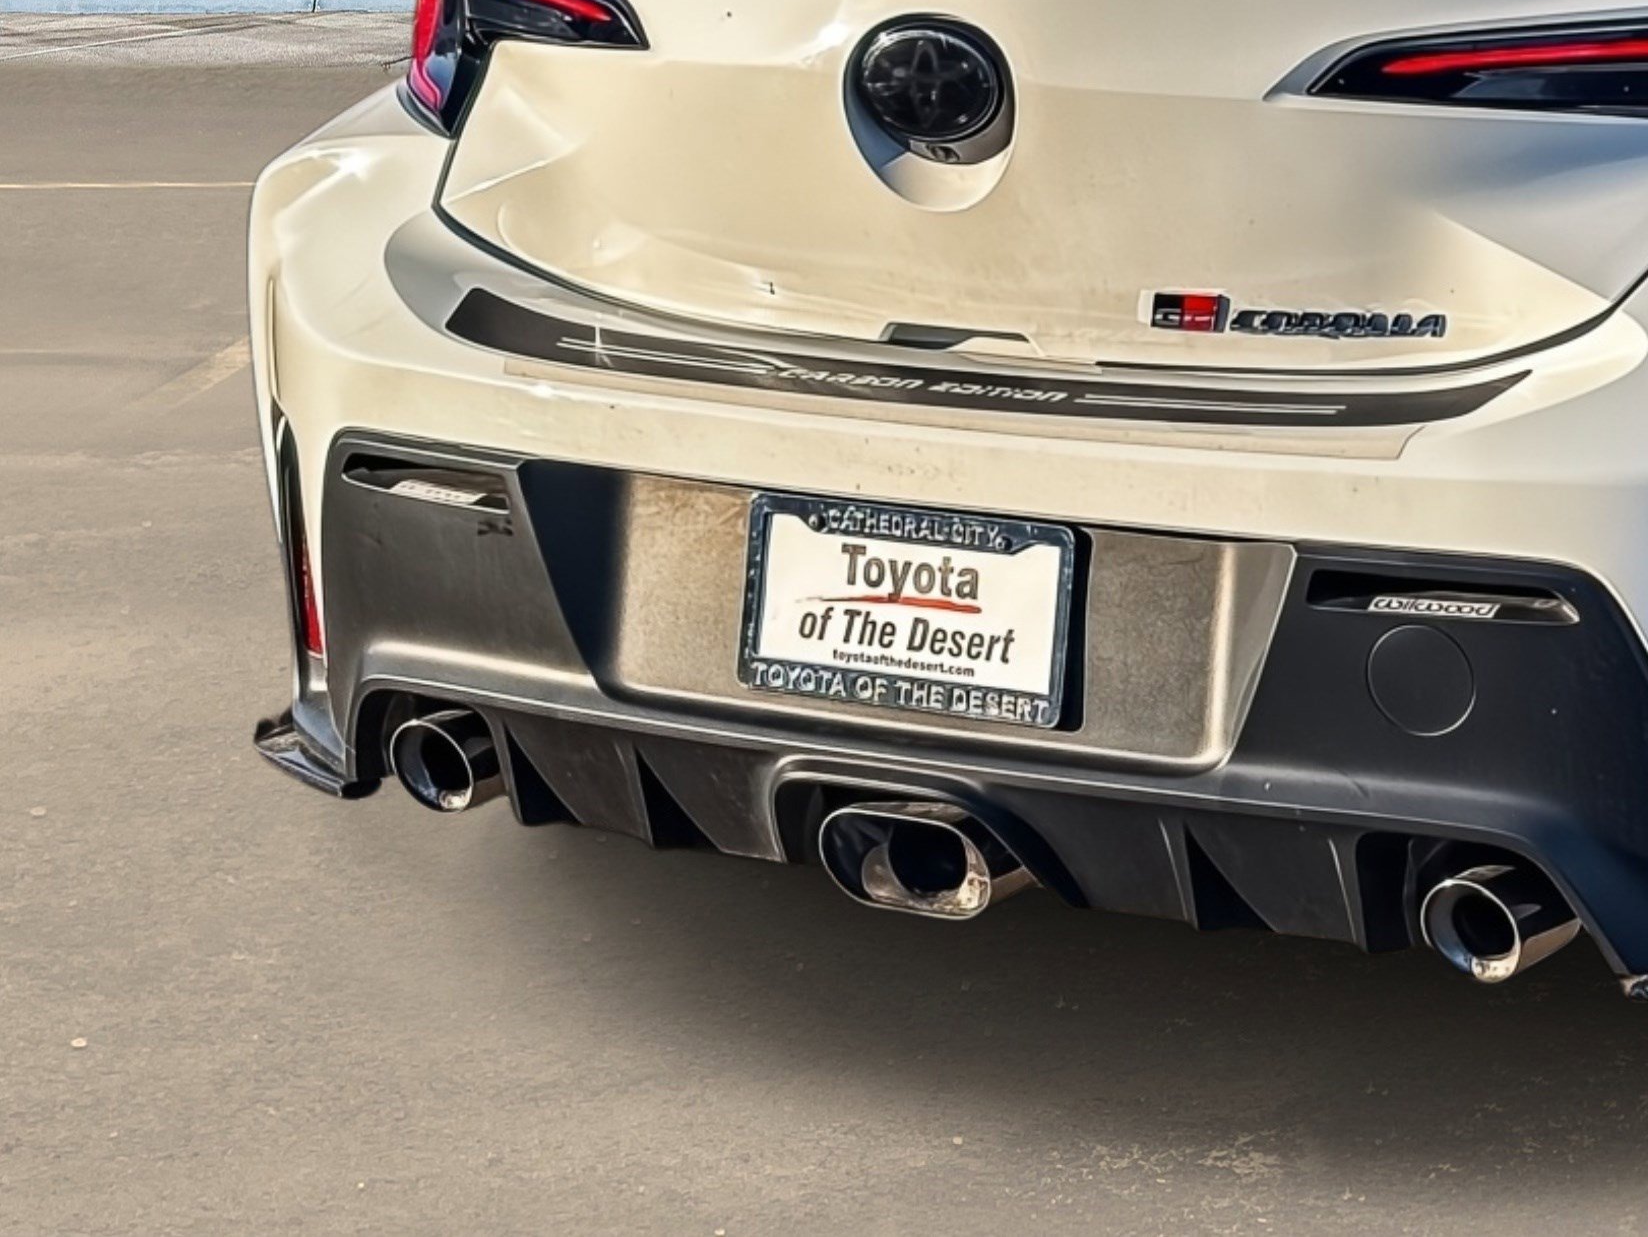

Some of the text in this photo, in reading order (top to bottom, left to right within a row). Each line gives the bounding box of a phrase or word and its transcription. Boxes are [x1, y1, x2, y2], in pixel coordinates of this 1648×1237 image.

[826, 507, 998, 548] CATHEDRAL CITY
[841, 543, 980, 602] Toyota
[798, 607, 1016, 664] of The Desert
[832, 648, 976, 678] toyotaofthedesert.com
[752, 662, 1051, 724] TOYOTA OF THE DESERT
